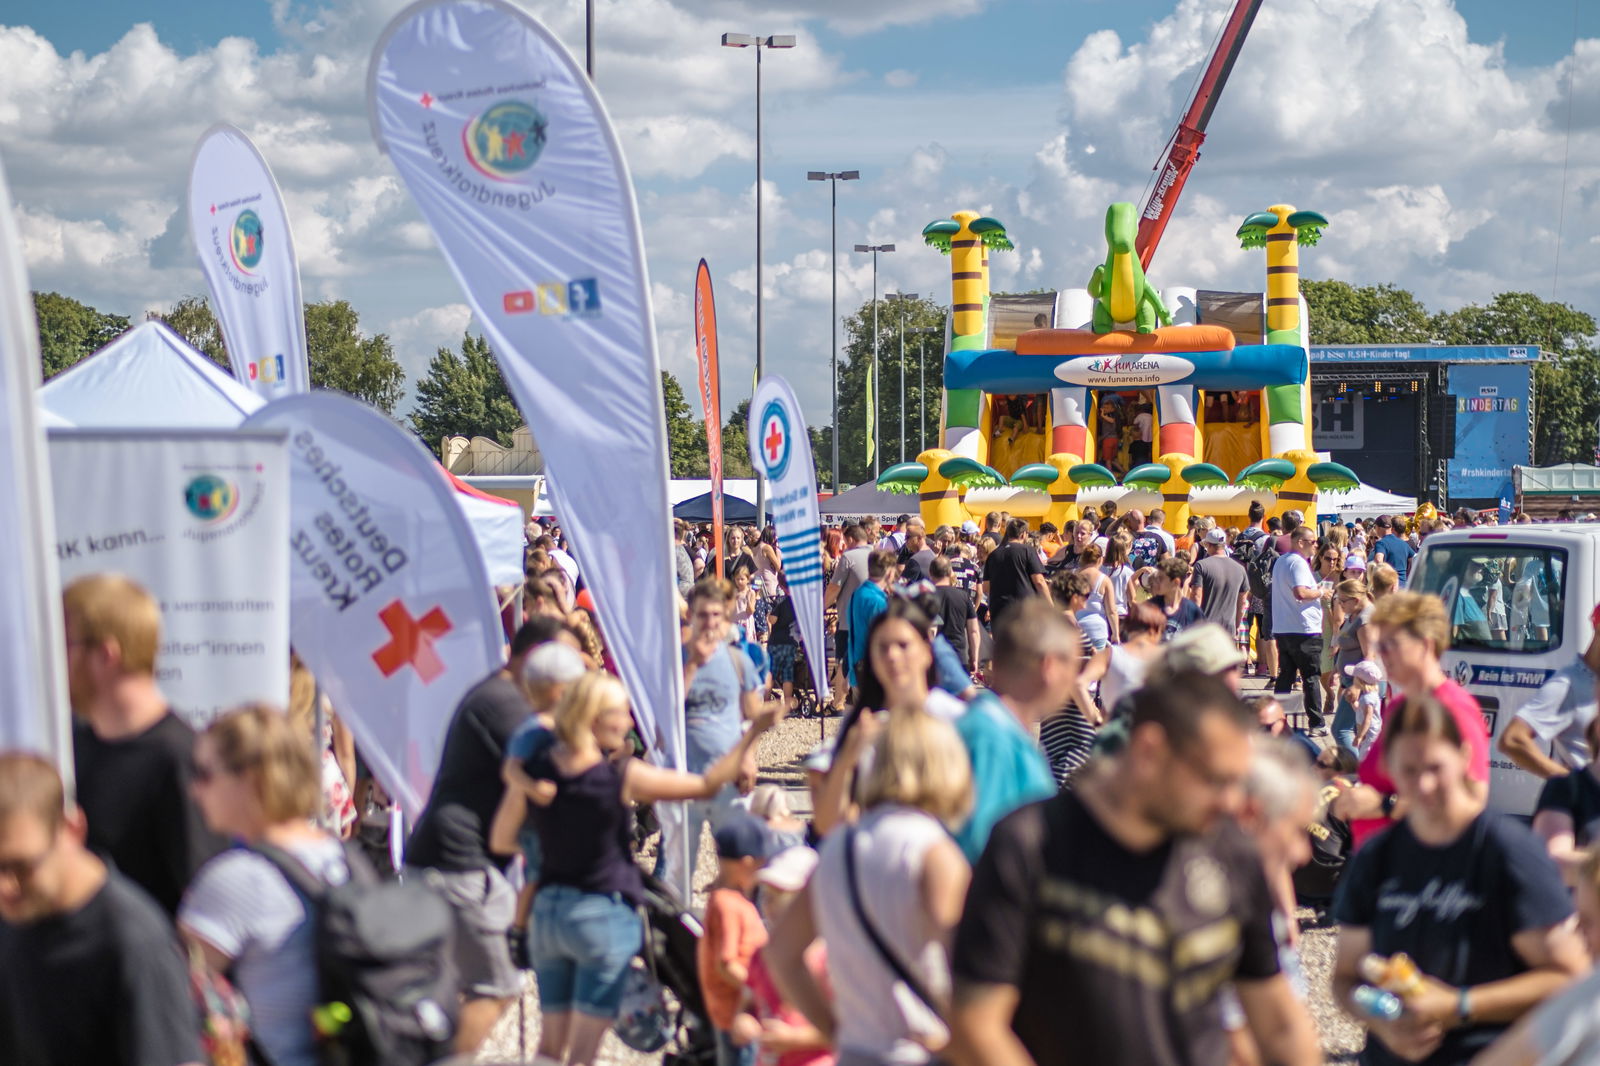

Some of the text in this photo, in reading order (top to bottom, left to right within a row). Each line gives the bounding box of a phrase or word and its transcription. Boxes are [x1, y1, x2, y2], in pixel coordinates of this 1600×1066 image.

[1311, 350, 1325, 360] paß
[1088, 374, 1160, 383] www.funarena.info
[1458, 398, 1518, 412] KINDERTAG
[1461, 467, 1512, 478] #rshkinderta
[1478, 670, 1545, 685] Rein ins THW!
